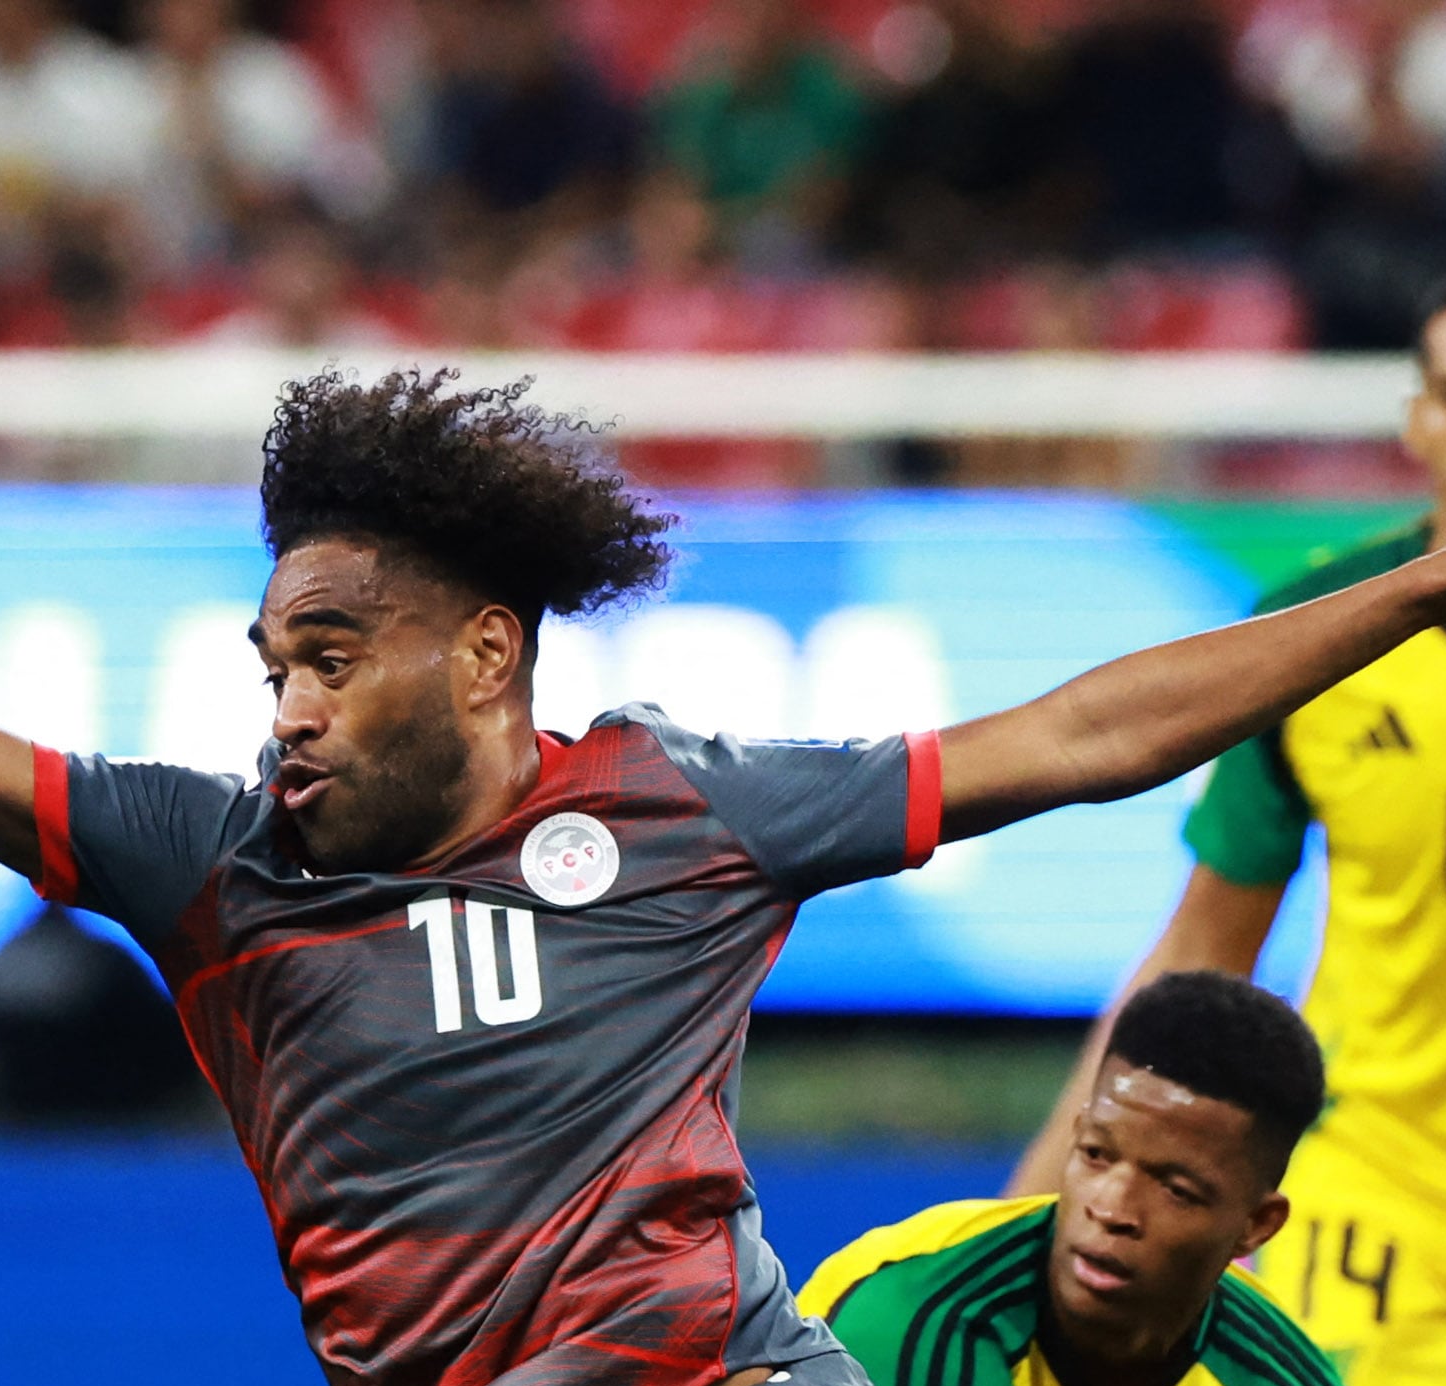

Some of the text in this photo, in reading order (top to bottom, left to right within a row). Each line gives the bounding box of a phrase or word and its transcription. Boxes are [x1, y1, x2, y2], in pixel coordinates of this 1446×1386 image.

[543, 845, 594, 874] FCF
[407, 896, 543, 1034] 10
[1296, 1217, 1416, 1325] 14
